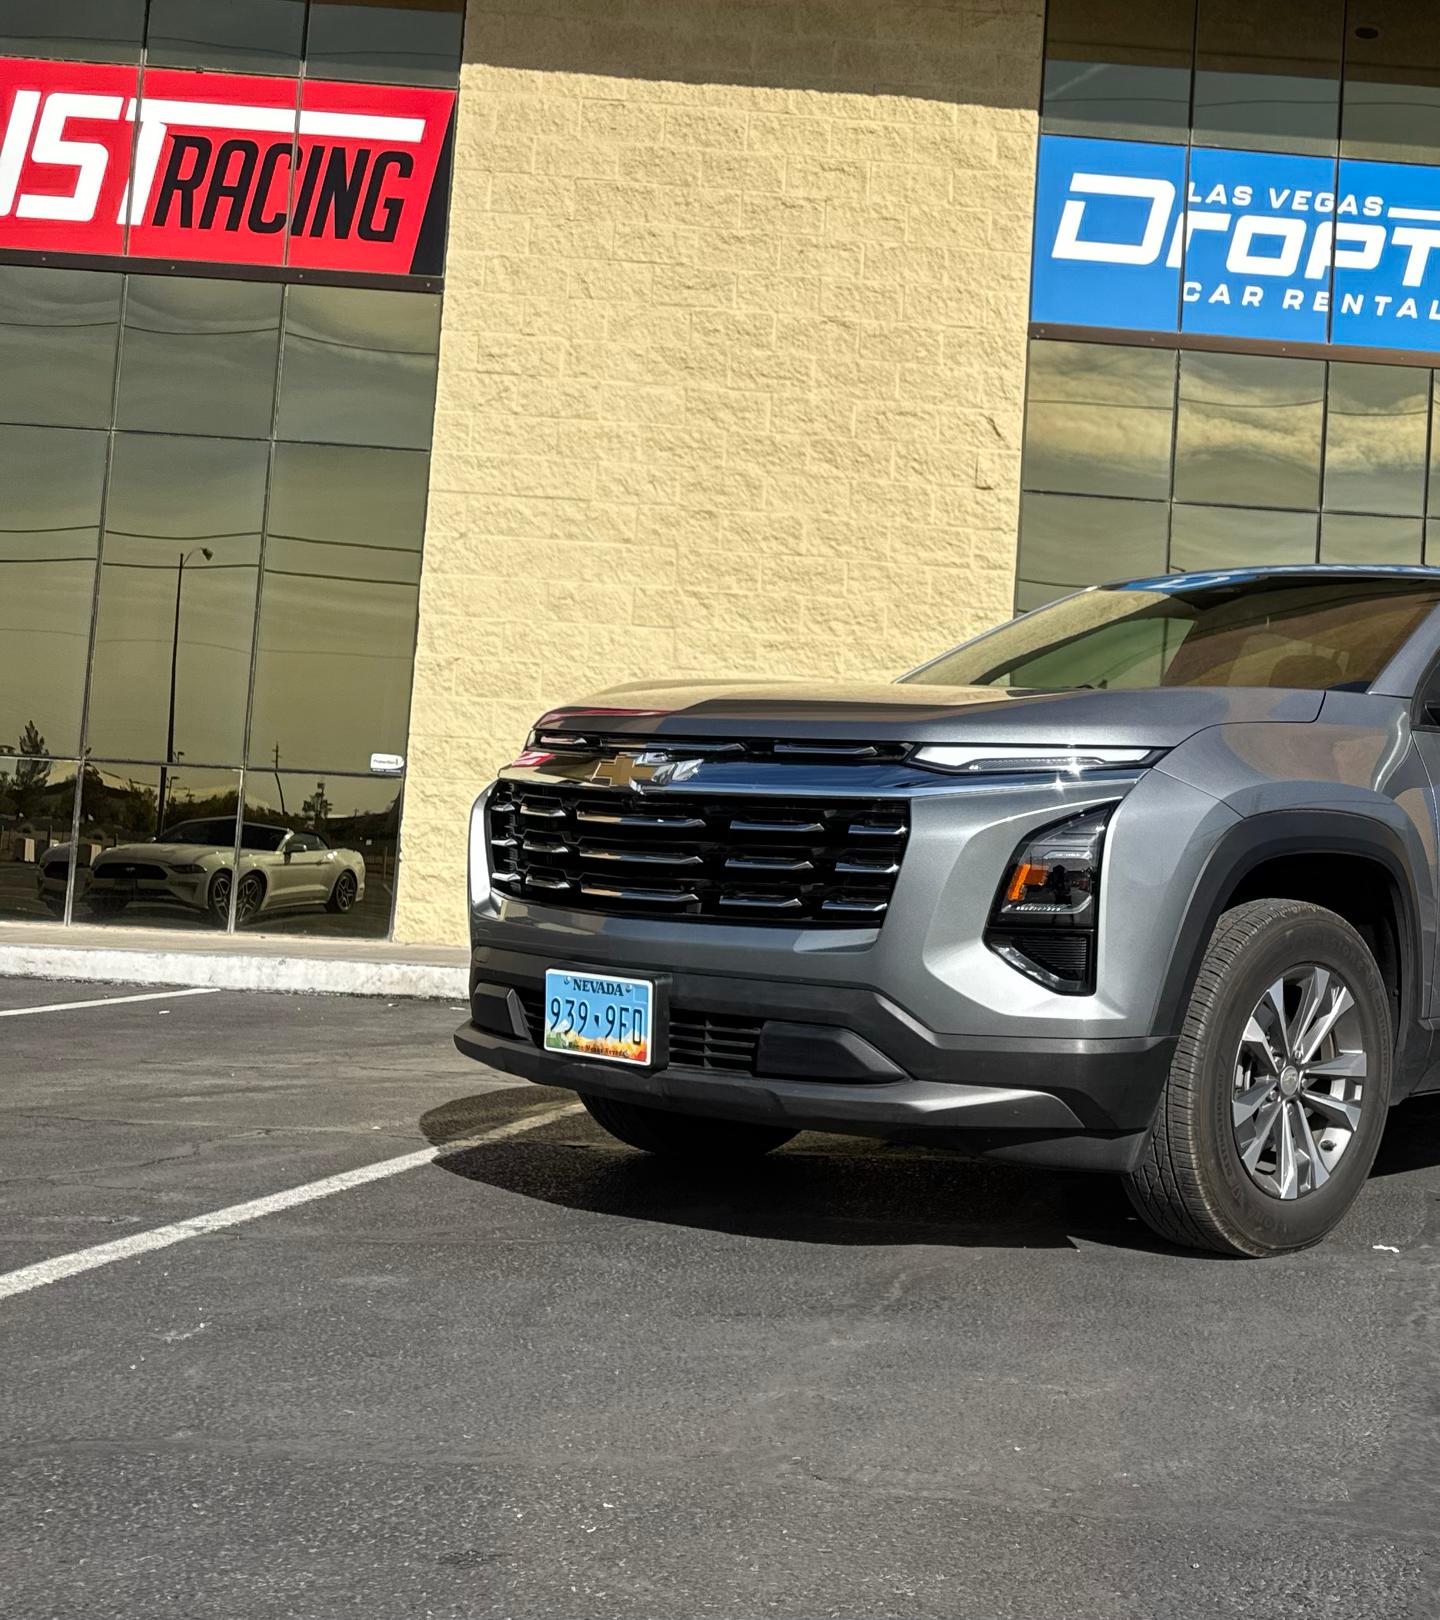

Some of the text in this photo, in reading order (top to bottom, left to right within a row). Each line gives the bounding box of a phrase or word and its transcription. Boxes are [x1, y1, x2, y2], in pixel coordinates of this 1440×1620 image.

[152, 133, 415, 243] RACING
[1187, 182, 1385, 218] LAS VEGAS
[1182, 281, 1264, 308] CAR
[573, 979, 624, 996] NEVADA
